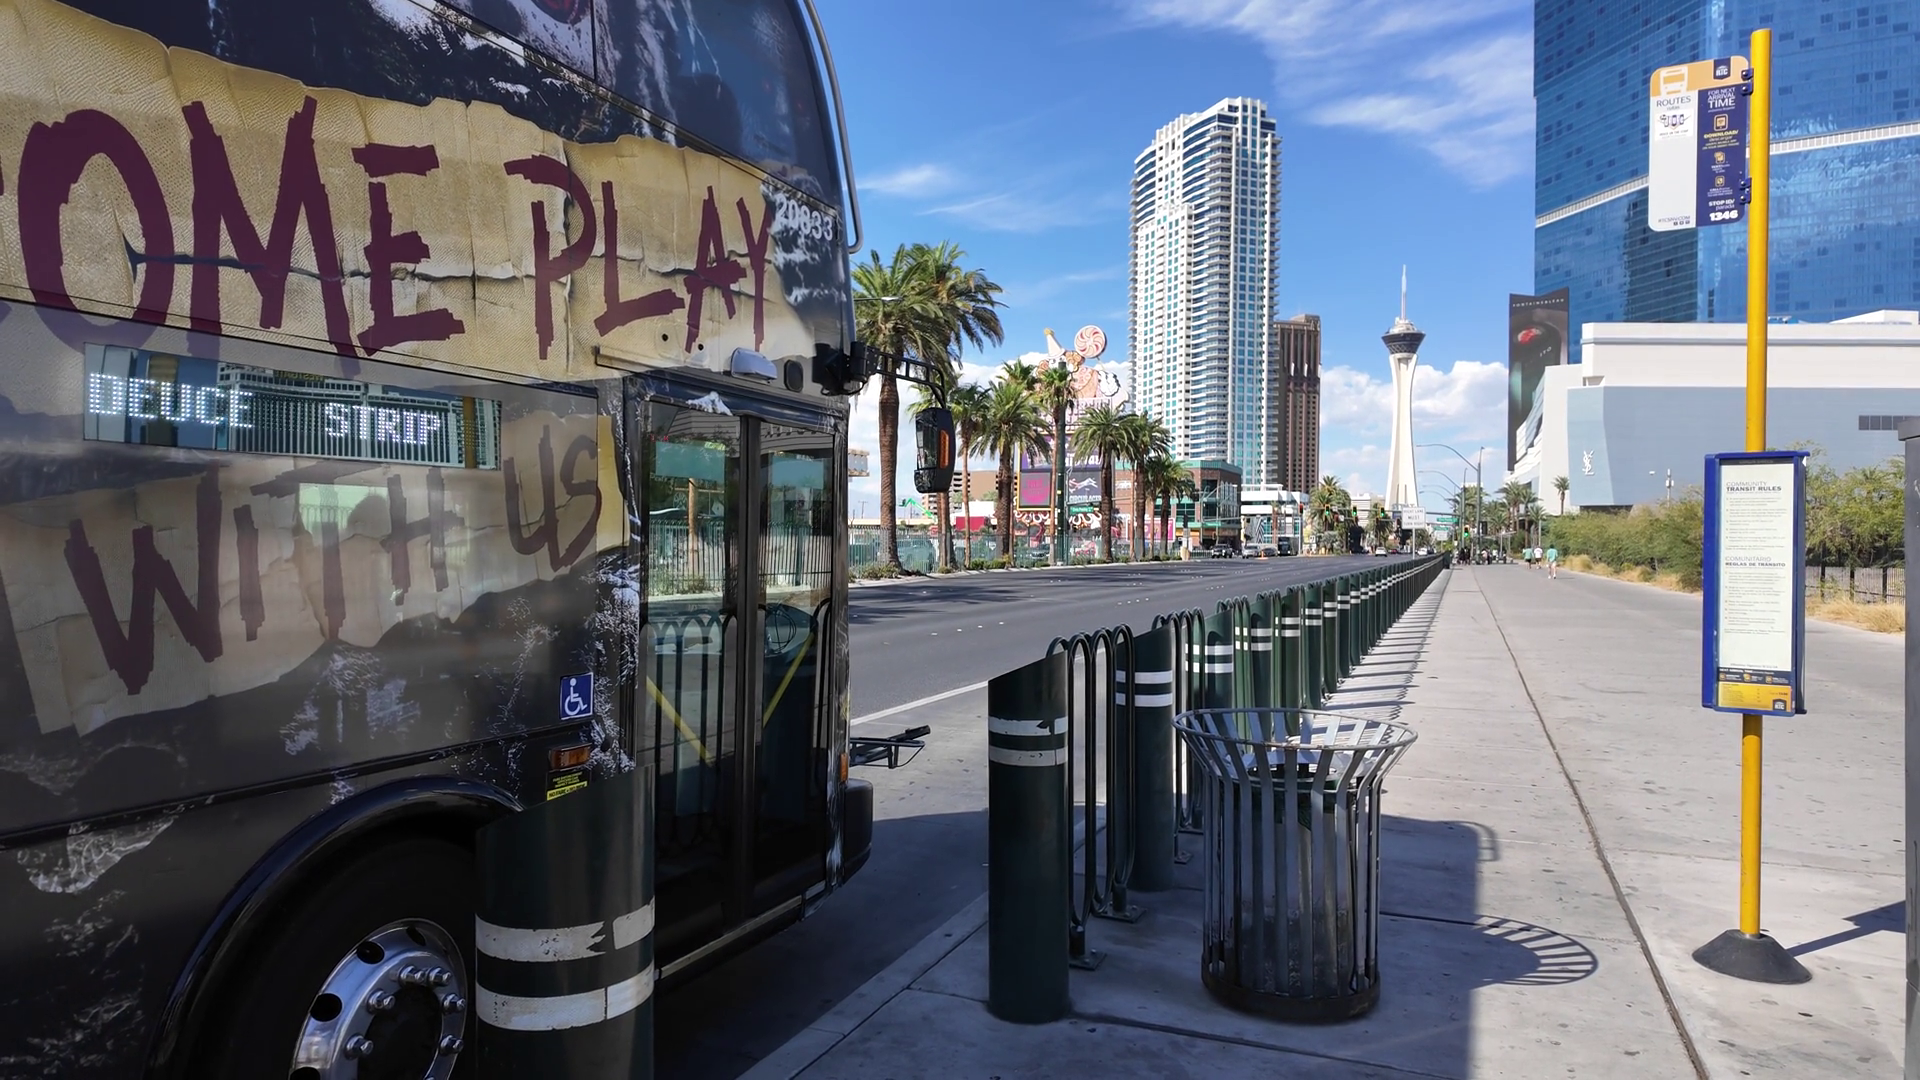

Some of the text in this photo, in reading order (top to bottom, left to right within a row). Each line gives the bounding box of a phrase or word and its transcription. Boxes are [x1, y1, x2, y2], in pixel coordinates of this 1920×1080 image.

[1656, 95, 1692, 108] ROUTES
[1707, 92, 1736, 101] ARRIVAL
[1707, 98, 1736, 109] TIME
[774, 191, 834, 241] 20833
[1709, 209, 1739, 222] 1346
[0, 94, 773, 378] OME PLAY
[89, 372, 442, 446] DEUCE STRIP
[64, 425, 602, 696] WITH US
